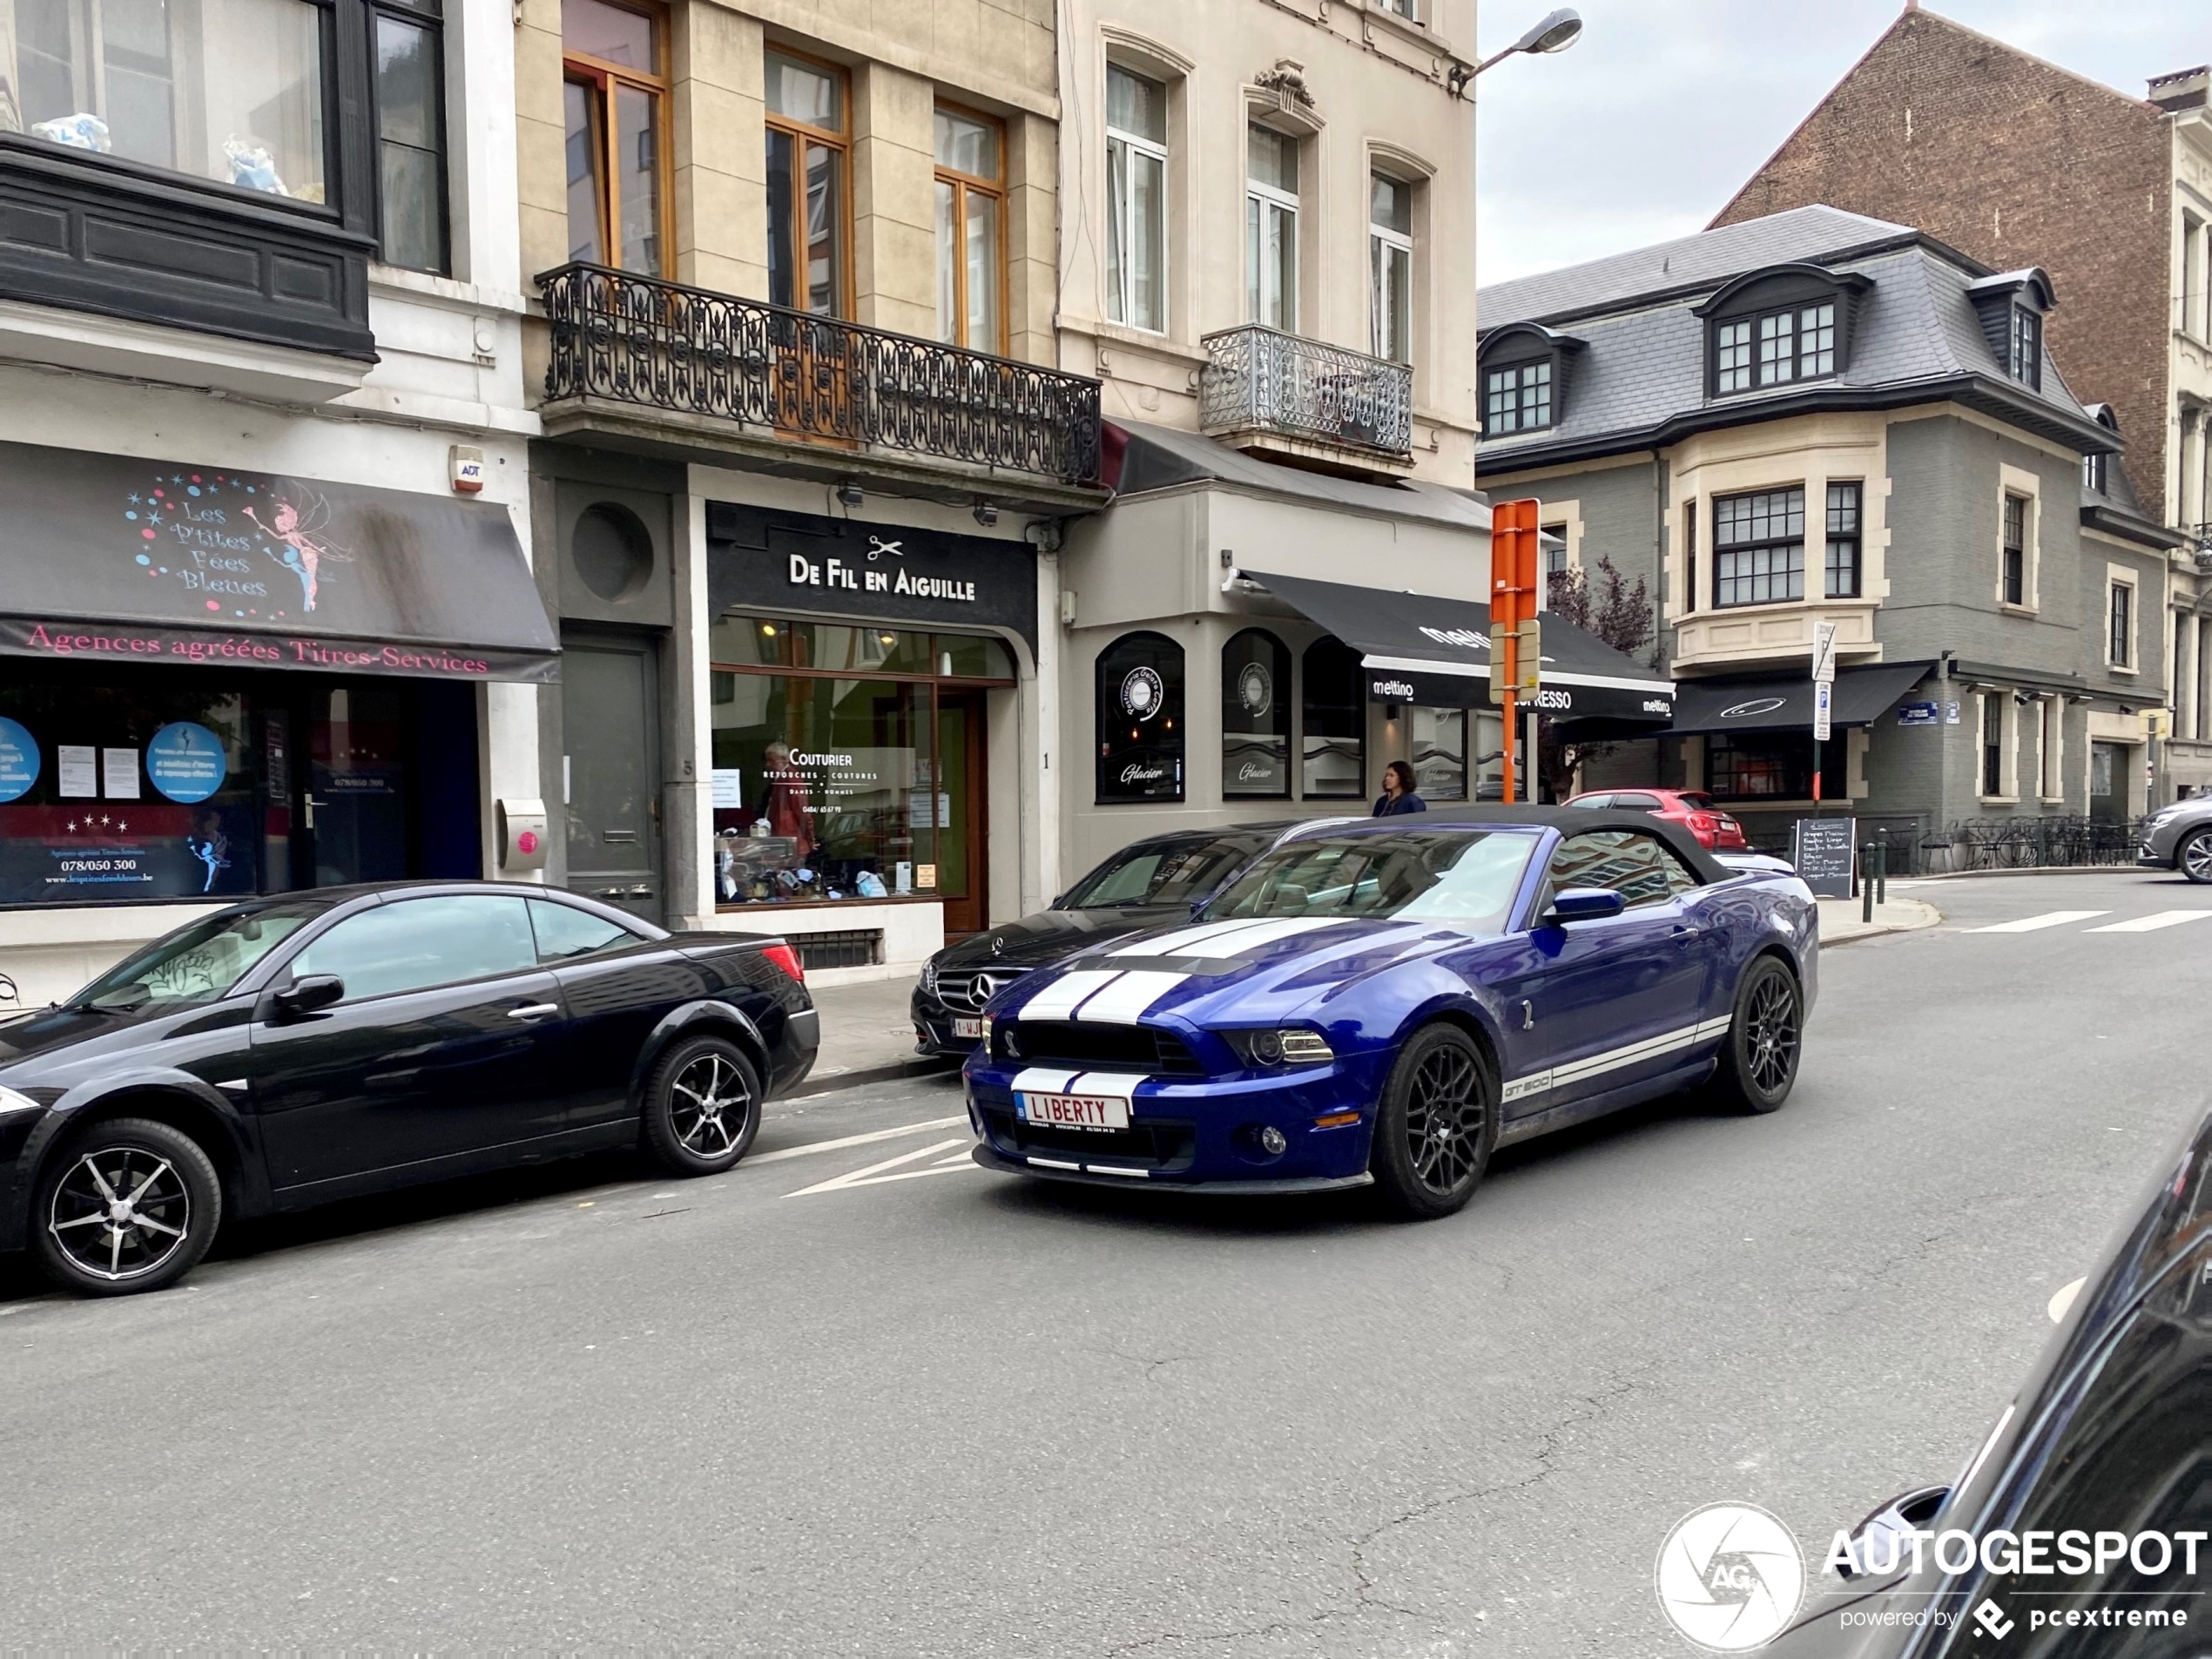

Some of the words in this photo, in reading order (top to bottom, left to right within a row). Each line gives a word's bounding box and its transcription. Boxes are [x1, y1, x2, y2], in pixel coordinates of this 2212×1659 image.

[462, 465, 480, 476] ADT
[181, 501, 226, 523] Les
[169, 523, 251, 551] P'tites
[190, 550, 251, 573] Fées
[176, 569, 267, 597] Bleues
[790, 554, 820, 584] DE
[827, 557, 858, 590] FIL
[865, 570, 887, 592] EN
[894, 567, 975, 601] AIGUILLE
[26, 624, 161, 654] Agences
[172, 638, 280, 661] agréées
[289, 641, 488, 673] Titres-Services
[1373, 681, 1413, 697] meltino
[1642, 699, 1670, 712] meltino
[789, 748, 853, 766] COUTURIER
[1043, 752, 1049, 770] 1
[1121, 763, 1163, 785] Glacier
[1238, 762, 1271, 783] Glacier
[61, 860, 111, 872] 078/050
[113, 860, 137, 870] 300
[957, 1021, 981, 1035] 1-WJ
[1018, 1108, 1025, 1116] B
[1031, 1096, 1105, 1124] LIBERTY
